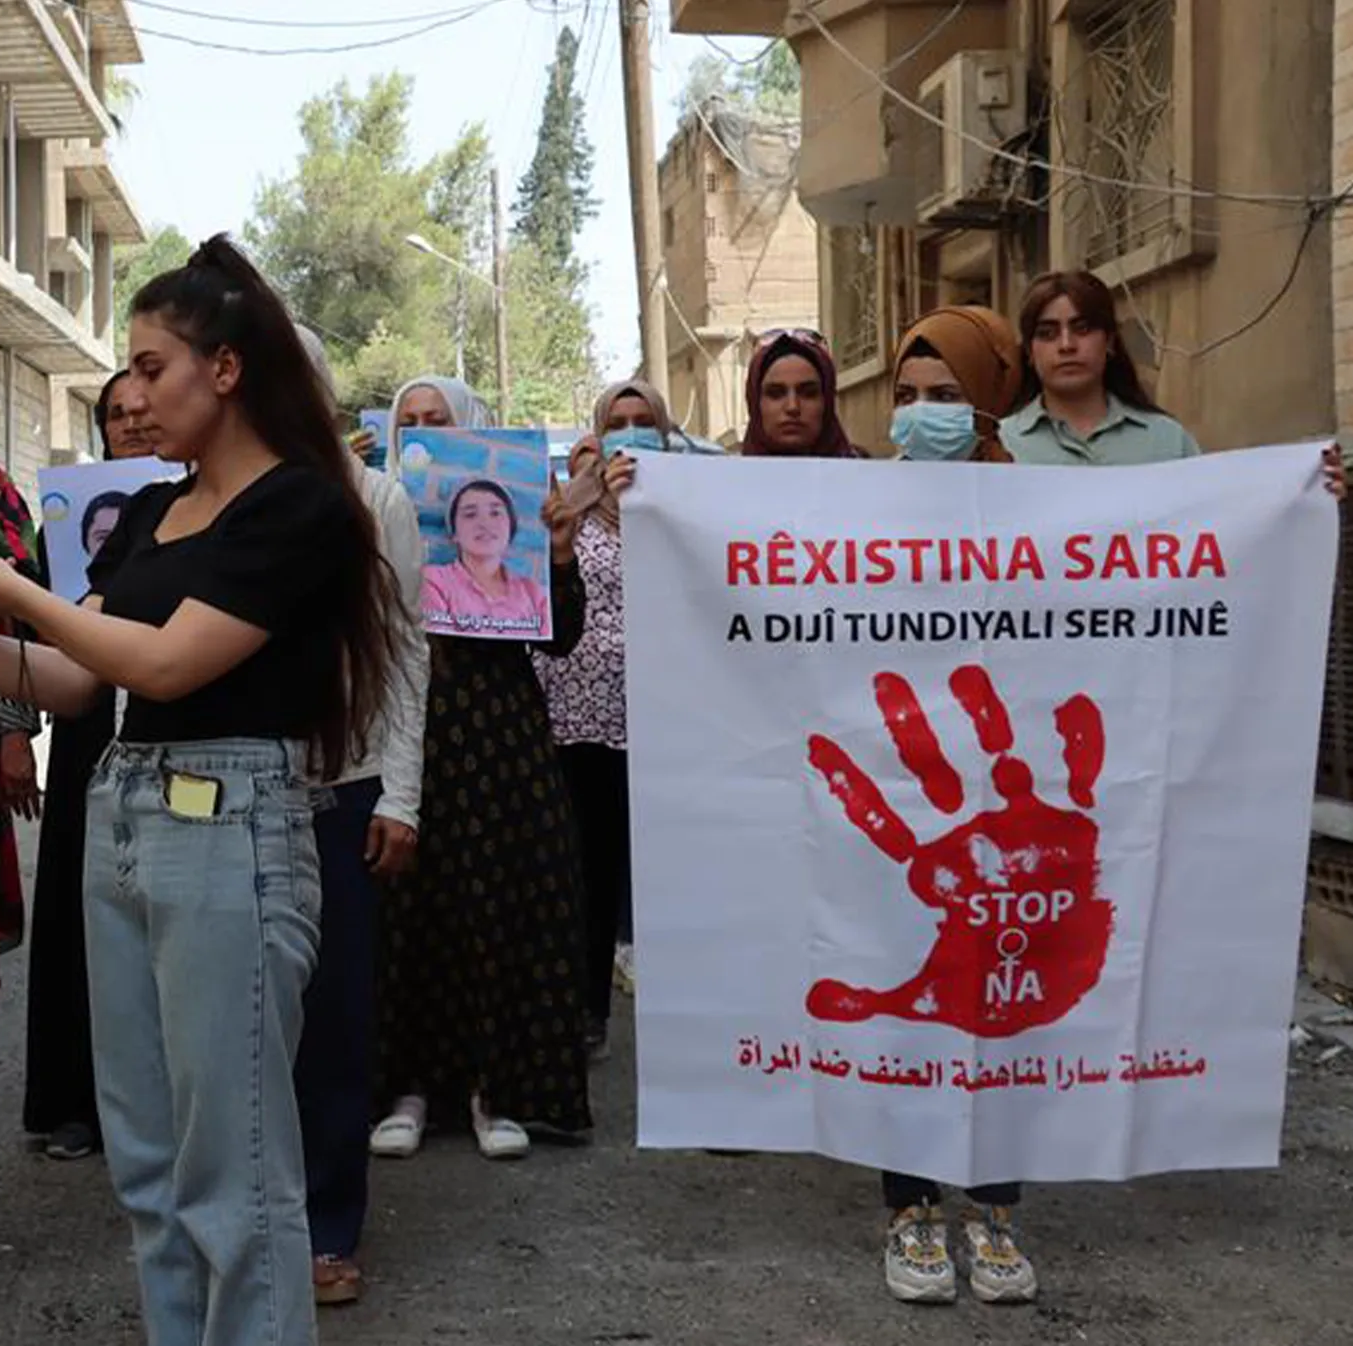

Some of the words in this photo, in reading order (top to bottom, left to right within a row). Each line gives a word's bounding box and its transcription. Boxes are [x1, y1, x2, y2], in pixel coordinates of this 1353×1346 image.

[727, 529, 1046, 586] RÊXISTINA
[1064, 533, 1226, 581] SARA
[727, 613, 753, 642] A
[764, 607, 836, 642] DIJÎ
[843, 609, 1053, 642] TUNDIYALI
[1064, 608, 1135, 639] SER
[1144, 600, 1228, 638] JINÊ
[967, 889, 1075, 926] STOP
[985, 969, 1045, 1004] NA
[739, 1035, 802, 1075] المرأة
[809, 1049, 852, 1077] ضد
[858, 1055, 944, 1087] العنف
[1055, 1055, 1111, 1091] سارا
[1119, 1049, 1207, 1083] منظمة
[951, 1056, 1047, 1092] لمناهضة
